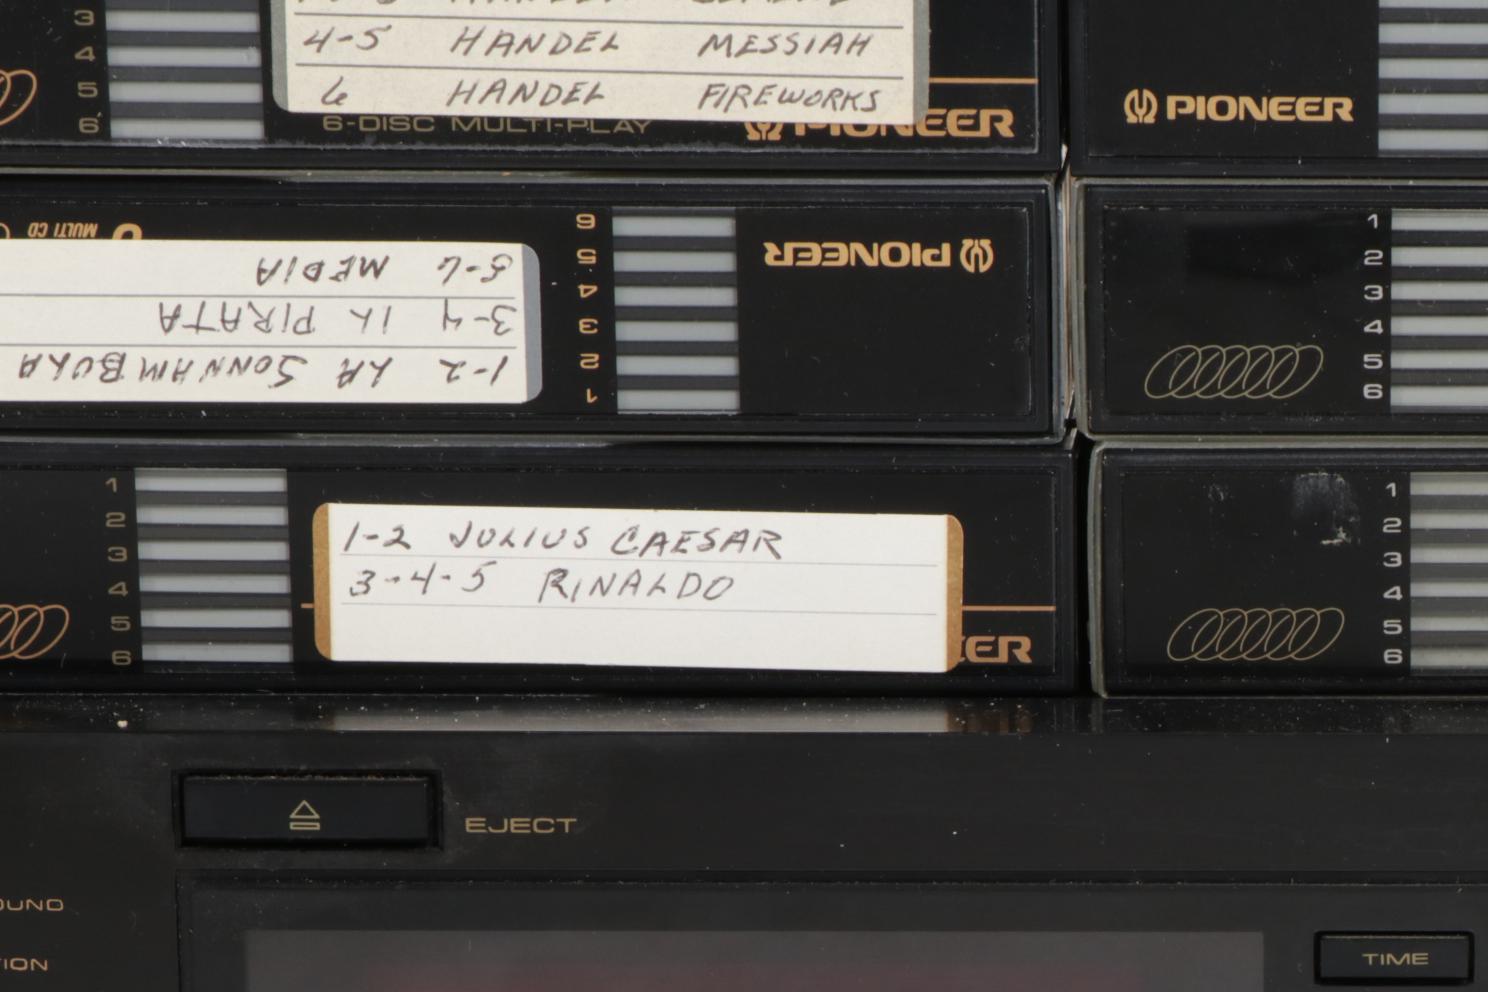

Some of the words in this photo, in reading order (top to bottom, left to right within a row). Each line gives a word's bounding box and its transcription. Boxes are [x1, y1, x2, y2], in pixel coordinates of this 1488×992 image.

[73, 9, 95, 27] 3
[303, 24, 393, 54] 4-5
[449, 26, 619, 58] HANDEL
[697, 31, 872, 59] MESSIAH
[74, 45, 96, 62] 4
[77, 81, 99, 98] 5
[320, 75, 348, 107] 6
[445, 78, 605, 107] HANDEL
[697, 82, 881, 114] FIREWORKS
[1166, 95, 1354, 122] PIONEER
[78, 117, 100, 134] 6
[322, 115, 434, 132] 6-DISC
[451, 117, 652, 134] MULTI-PLAY
[575, 213, 596, 230] 6
[1367, 213, 1378, 229] 1
[27, 222, 48, 238] CD
[54, 223, 98, 238] MULTI
[576, 248, 597, 265] 5
[763, 241, 951, 268] PIONEER
[1363, 249, 1384, 266] 2
[256, 255, 390, 287] MEDIA
[577, 283, 598, 299] 4
[1363, 284, 1384, 301] 3
[158, 300, 316, 336] PIRATA
[351, 305, 392, 331] IL
[435, 296, 518, 337] 3-4
[578, 318, 599, 335] 3
[1363, 319, 1384, 335] 4
[579, 353, 600, 370] 2
[1363, 353, 1384, 370] 5
[337, 356, 393, 389] LA
[439, 355, 509, 386] 1-2
[586, 388, 598, 404] 1
[1362, 383, 1383, 400] 6
[105, 477, 118, 493] 1
[1385, 482, 1397, 498] 1
[105, 511, 126, 528] 2
[1382, 517, 1402, 534] 2
[343, 522, 412, 552] 1-2
[448, 520, 590, 550] JULIUS
[610, 525, 782, 560] CAESAR
[107, 546, 128, 563] 3
[1383, 551, 1403, 568] 3
[107, 581, 129, 597] 4
[348, 560, 498, 598] 3-4-5
[537, 567, 735, 604] RINALDO
[1383, 585, 1403, 601] 4
[110, 615, 131, 632] 5
[1383, 619, 1403, 635] 5
[111, 649, 132, 666] 6
[1383, 648, 1403, 665] 6
[464, 817, 577, 834] EJECT
[0, 898, 64, 912] UND
[0, 957, 49, 971] ION
[1362, 952, 1429, 966] TIME
